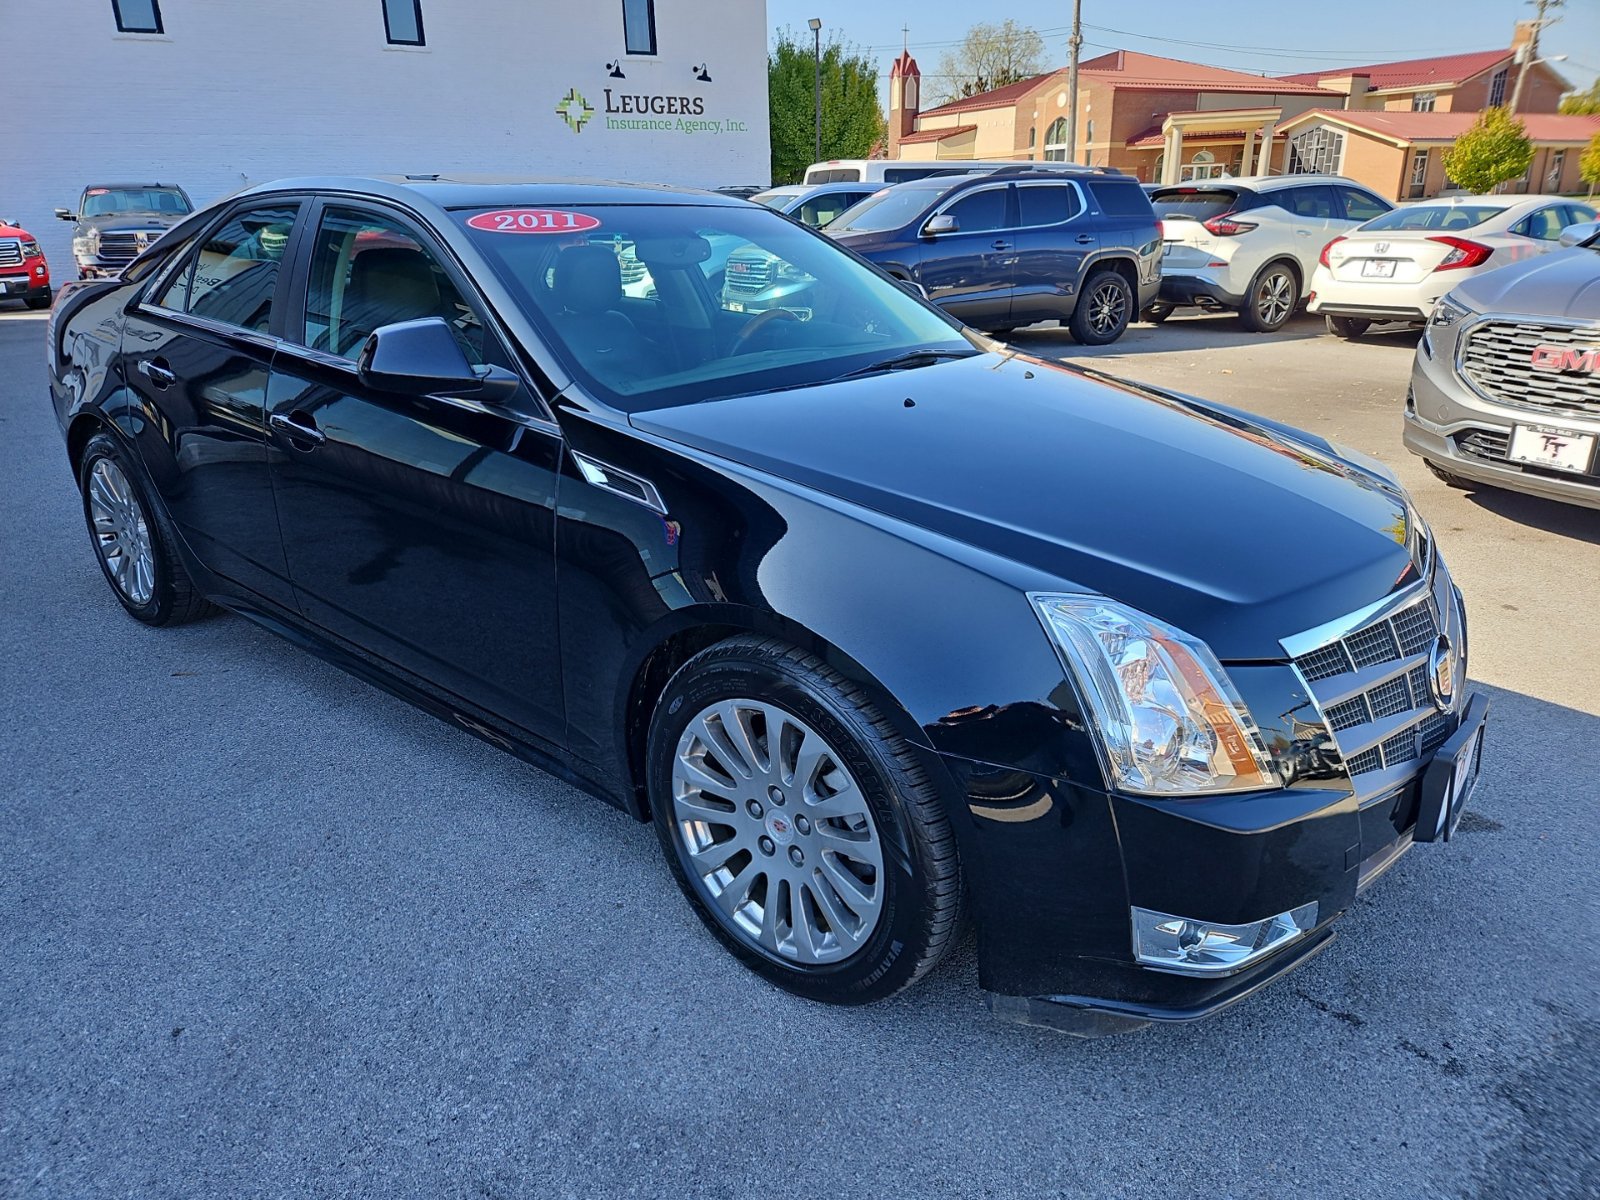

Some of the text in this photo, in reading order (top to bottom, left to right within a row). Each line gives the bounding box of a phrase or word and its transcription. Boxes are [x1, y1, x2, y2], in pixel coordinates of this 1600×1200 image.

[603, 88, 704, 115] LEUGERS
[606, 116, 748, 134] Insurance Agency, Inc.
[493, 212, 580, 231] 2011
